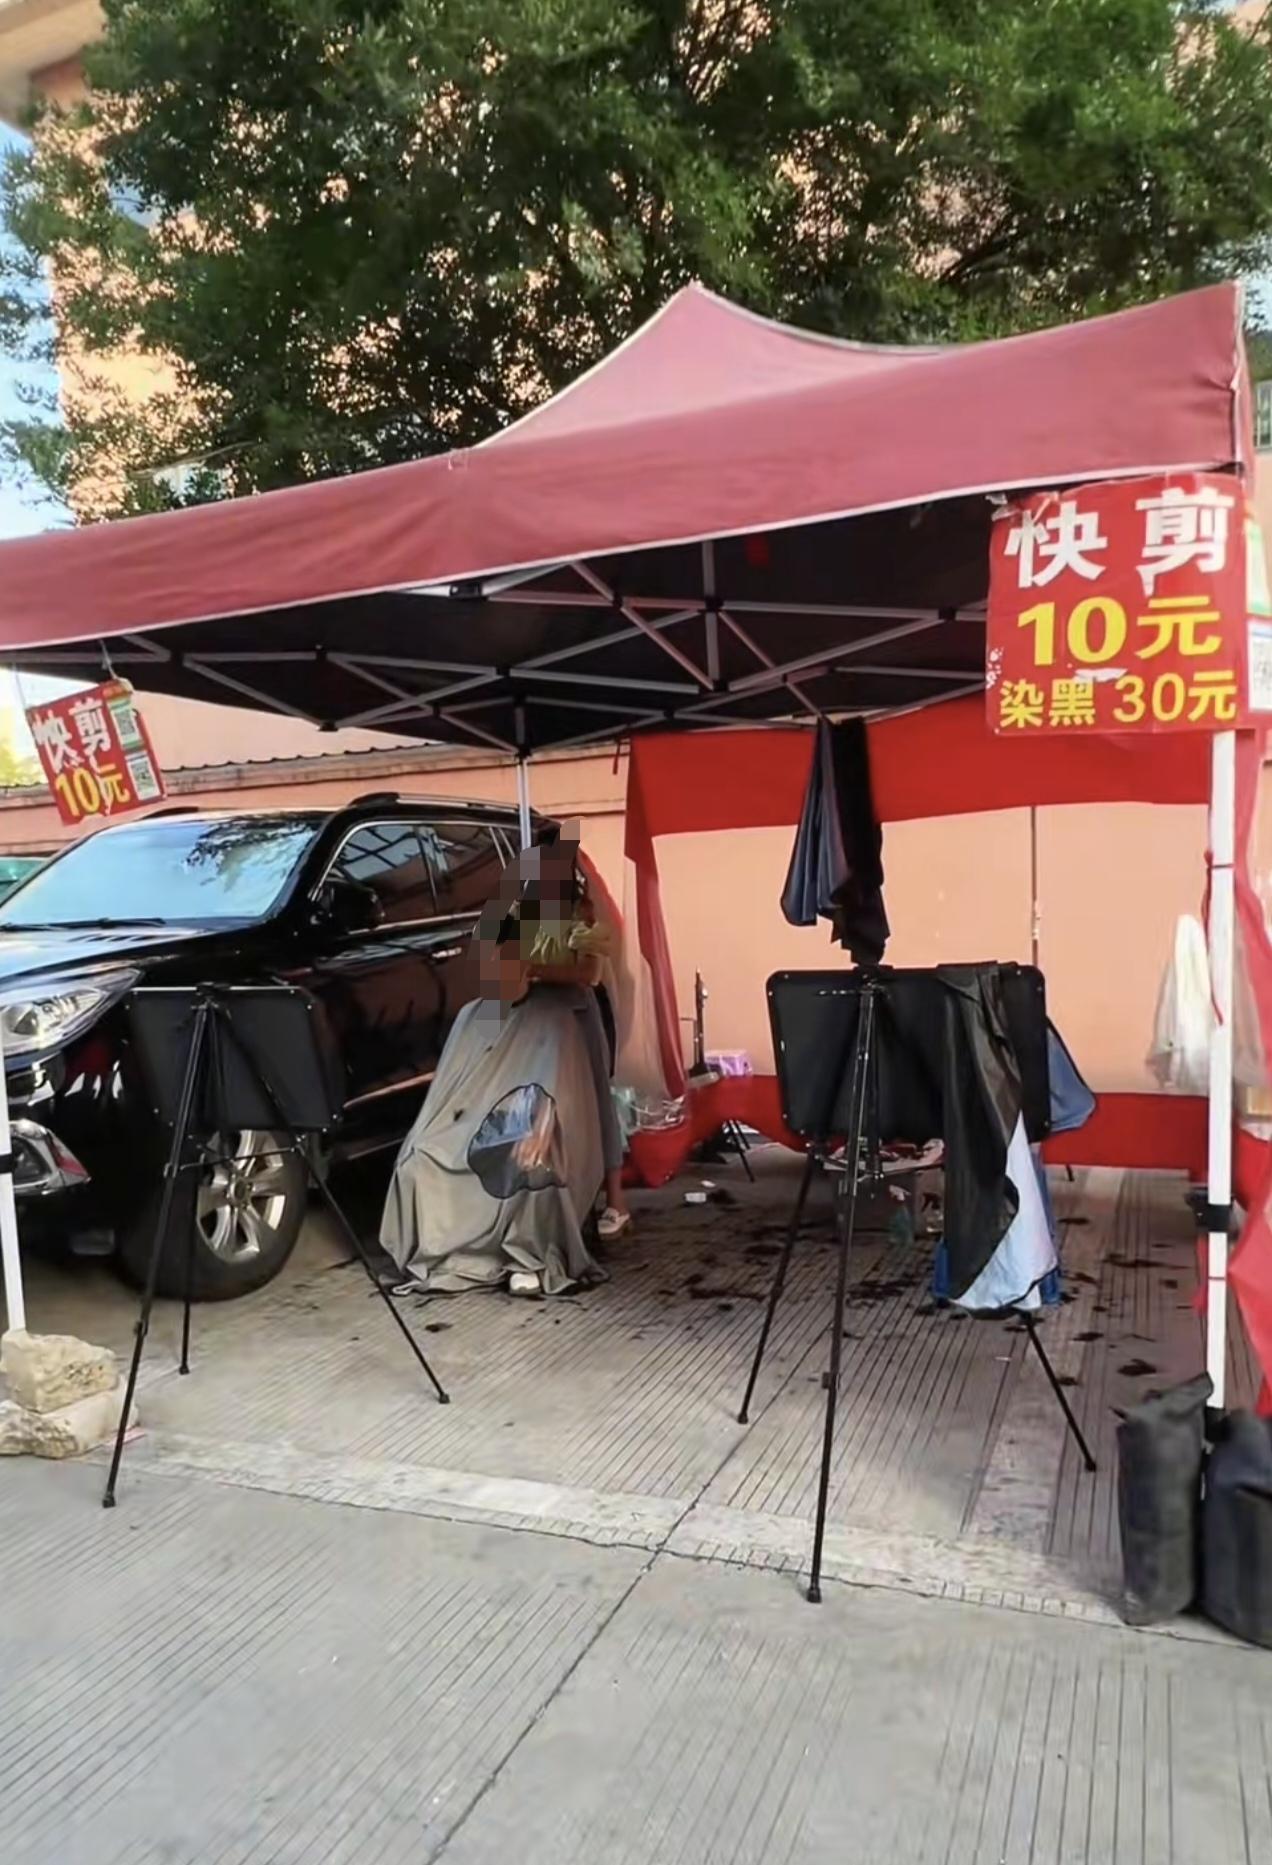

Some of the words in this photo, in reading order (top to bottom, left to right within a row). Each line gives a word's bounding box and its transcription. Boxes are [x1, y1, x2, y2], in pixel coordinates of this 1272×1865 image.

[1004, 487, 1235, 589] 快剪
[1018, 595, 1223, 666] 10元
[32, 697, 112, 774] 快剪
[55, 762, 131, 817] 10元
